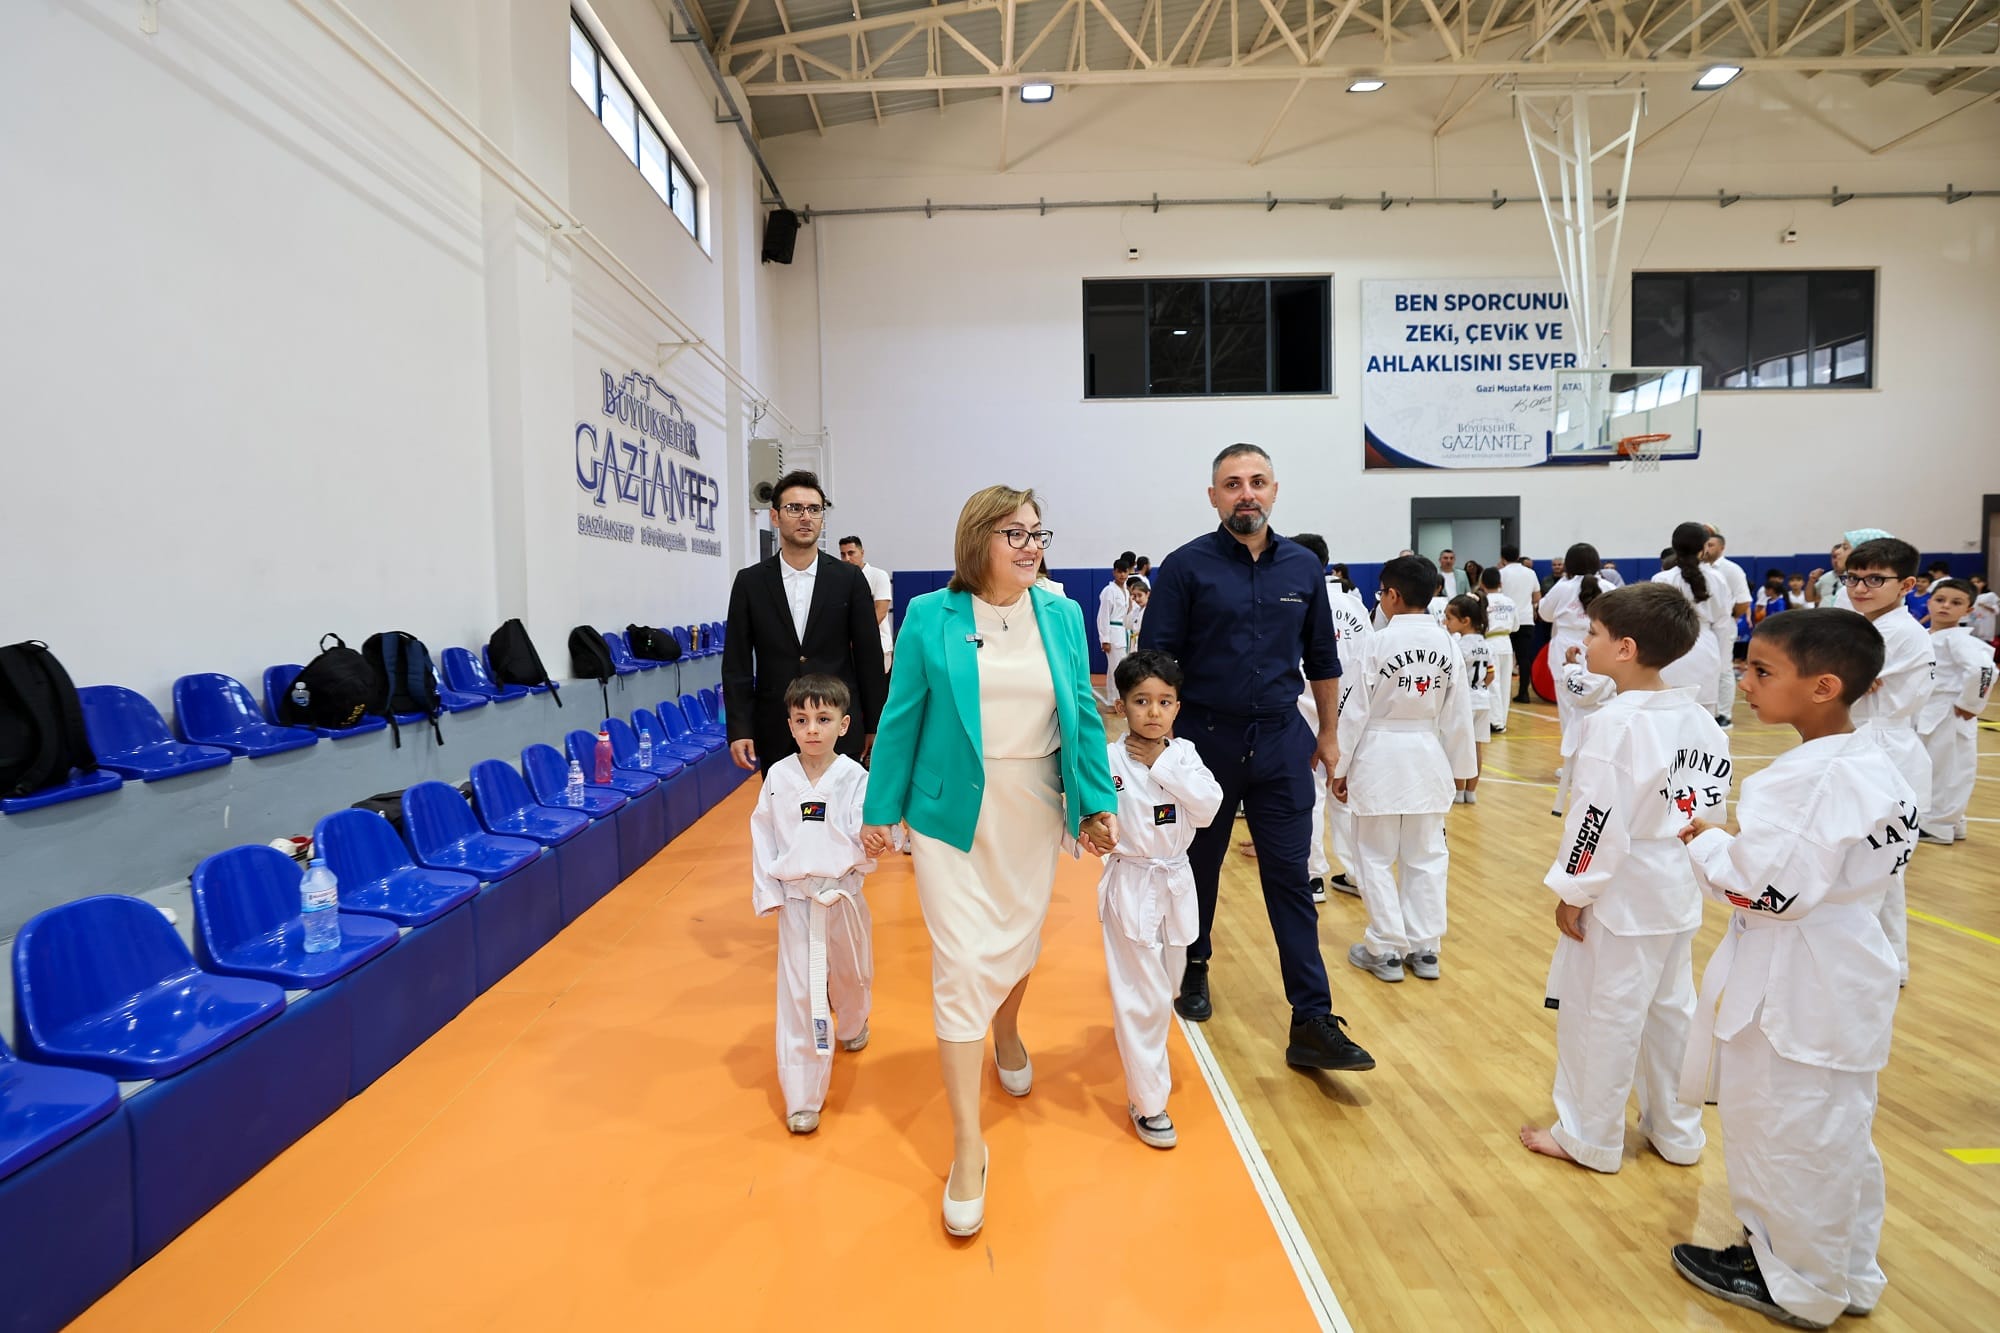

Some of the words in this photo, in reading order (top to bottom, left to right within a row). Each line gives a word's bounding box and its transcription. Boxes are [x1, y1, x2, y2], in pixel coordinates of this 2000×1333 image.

[1395, 294, 1438, 311] BEN
[1535, 323, 1563, 340] VE
[1366, 354, 1502, 373] AHLAKLISINI
[1476, 384, 1495, 393] Gazi
[1497, 383, 1531, 392] Mustafa
[1533, 383, 1553, 392] Kem
